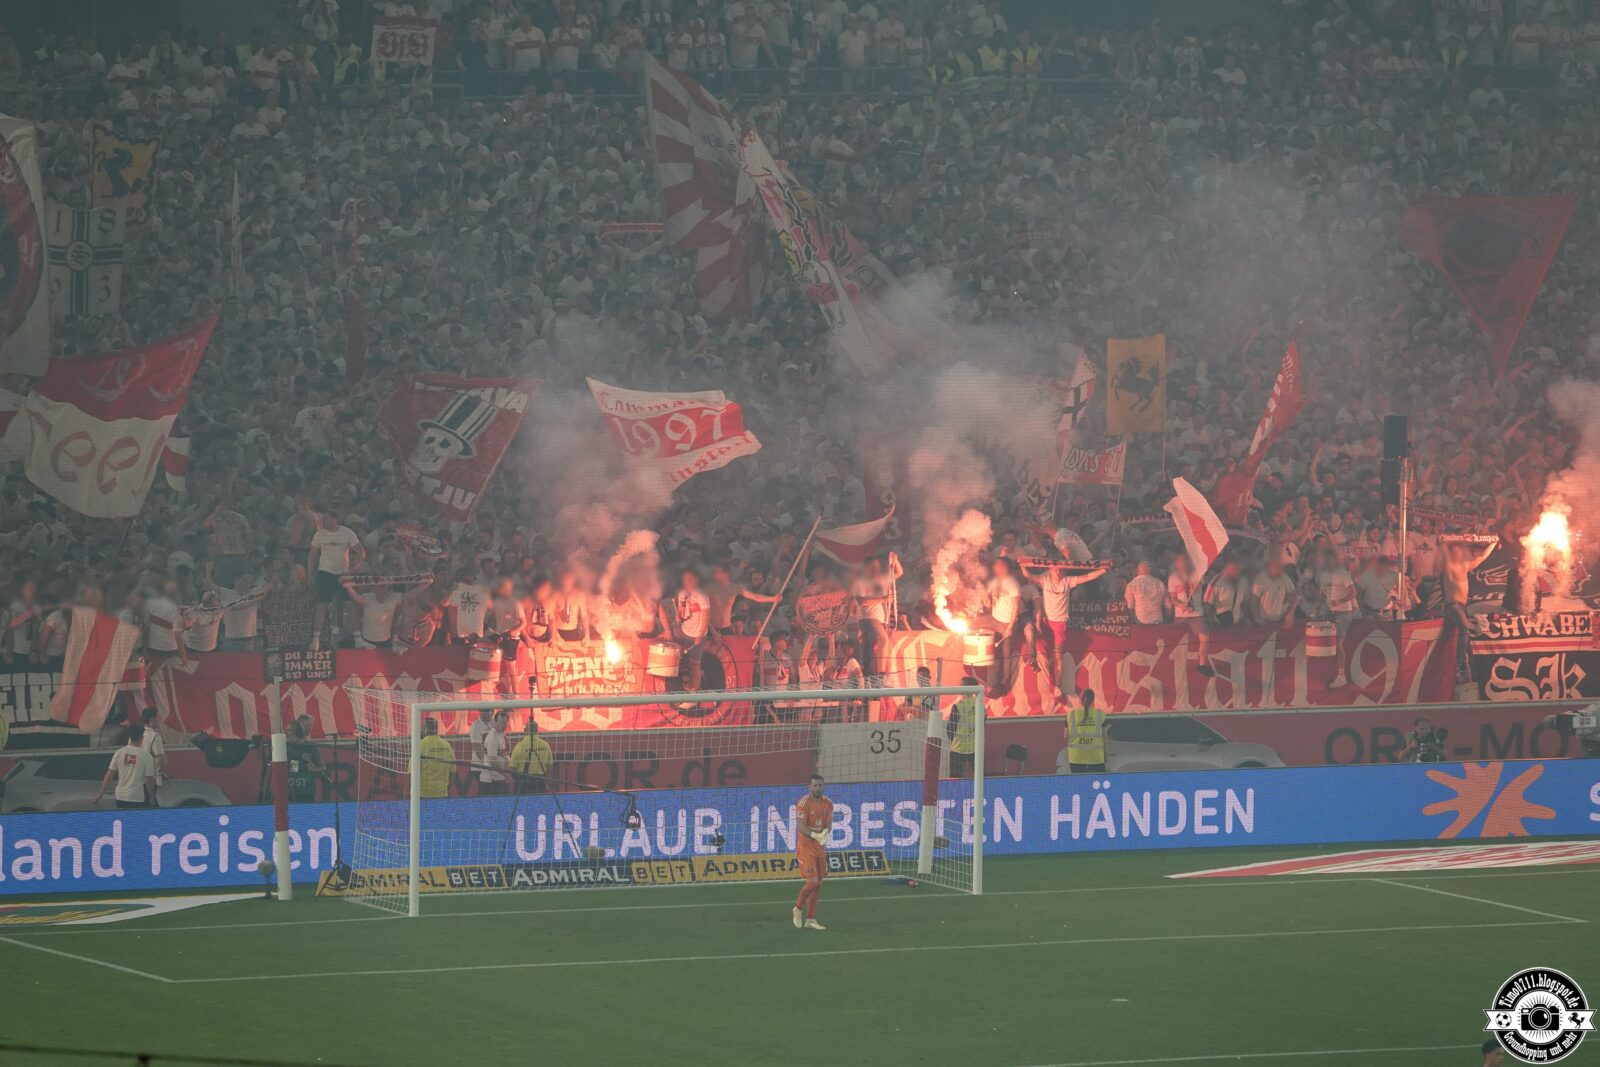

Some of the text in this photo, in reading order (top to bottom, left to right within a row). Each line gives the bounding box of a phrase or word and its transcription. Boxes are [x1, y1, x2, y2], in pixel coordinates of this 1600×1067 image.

[610, 408, 728, 457] 1997
[1071, 601, 1102, 612] LTRA
[1472, 612, 1593, 639] CHWABE
[285, 651, 332, 662] DU BIST
[285, 660, 332, 671] IMMER
[886, 631, 1316, 717] Cnnstatt
[1349, 626, 1442, 706] 97
[869, 730, 901, 753] 35
[516, 780, 1255, 864] URLAUB IN BESTEN HÄNDEN
[149, 805, 340, 874] reisen
[451, 870, 499, 885] BET
[513, 869, 629, 886] ADMIRAL
[637, 865, 686, 879] BET
[703, 858, 806, 877] ADMIRA
